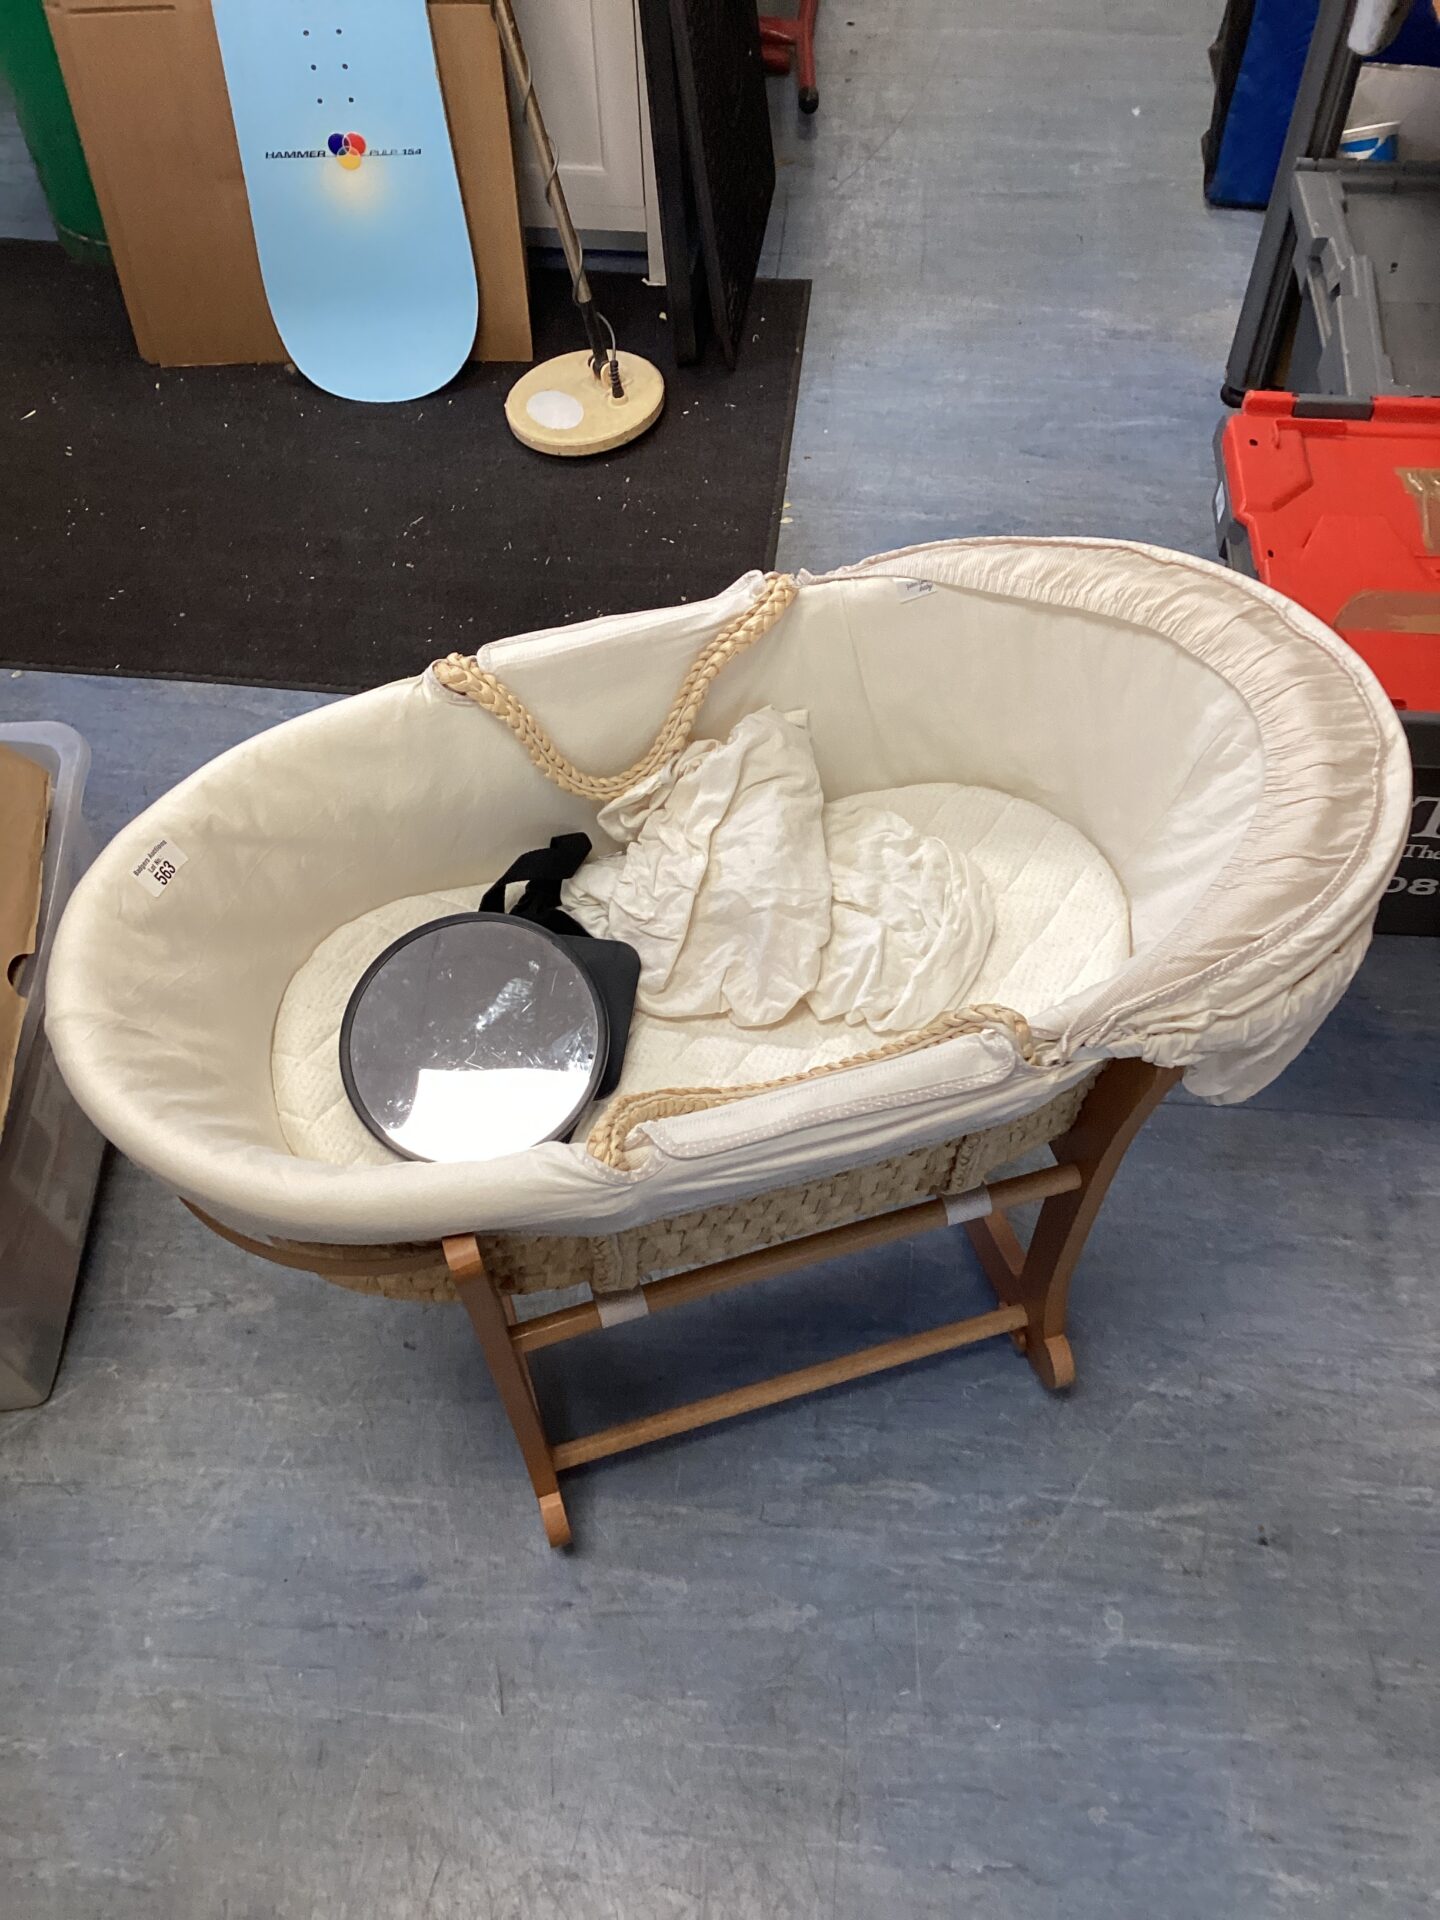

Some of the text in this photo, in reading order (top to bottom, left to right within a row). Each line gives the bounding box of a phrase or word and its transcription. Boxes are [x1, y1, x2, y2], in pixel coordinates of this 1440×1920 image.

[265, 150, 326, 159] HAMMER
[402, 148, 422, 156] 154
[133, 840, 167, 877] Badgers Auctions
[154, 860, 176, 885] 563
